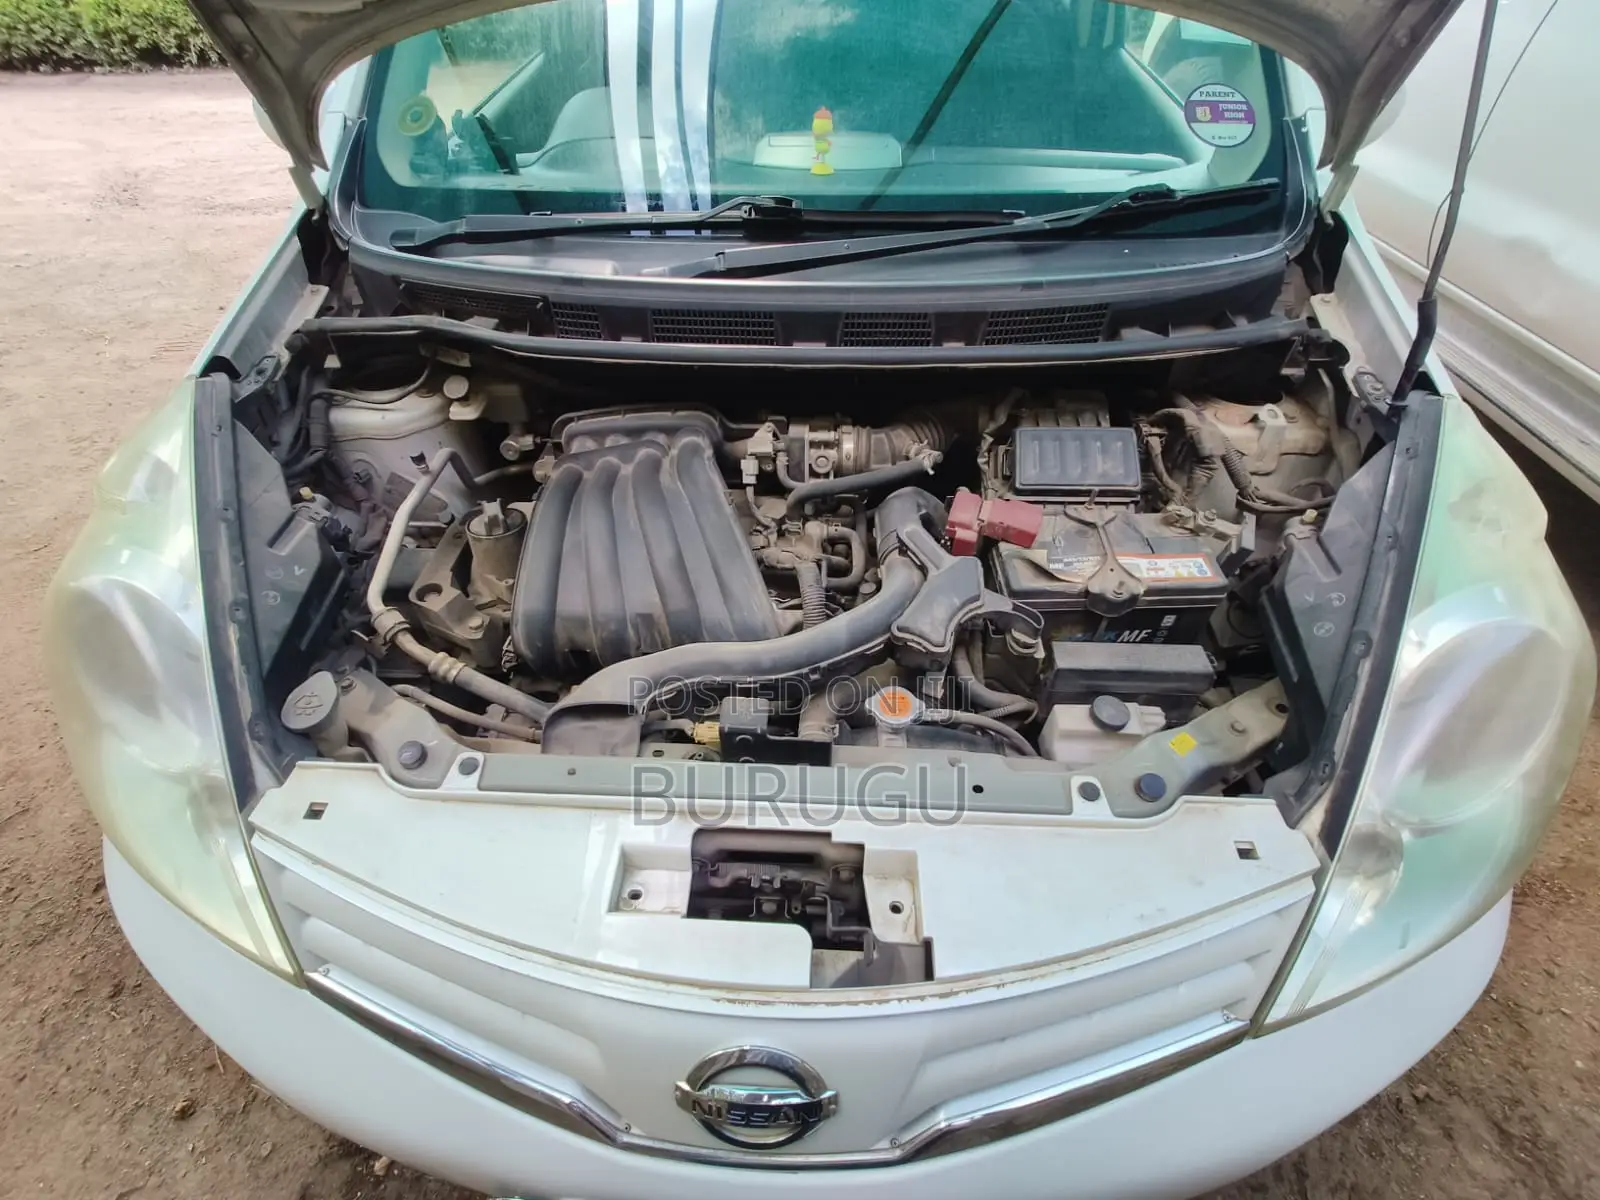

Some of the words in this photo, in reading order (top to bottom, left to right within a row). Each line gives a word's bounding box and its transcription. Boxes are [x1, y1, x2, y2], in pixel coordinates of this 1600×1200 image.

[1199, 90, 1235, 98] PARENT
[1219, 103, 1248, 111] JUNIOR
[1116, 629, 1152, 643] MF
[692, 1099, 822, 1126] NISSAN
